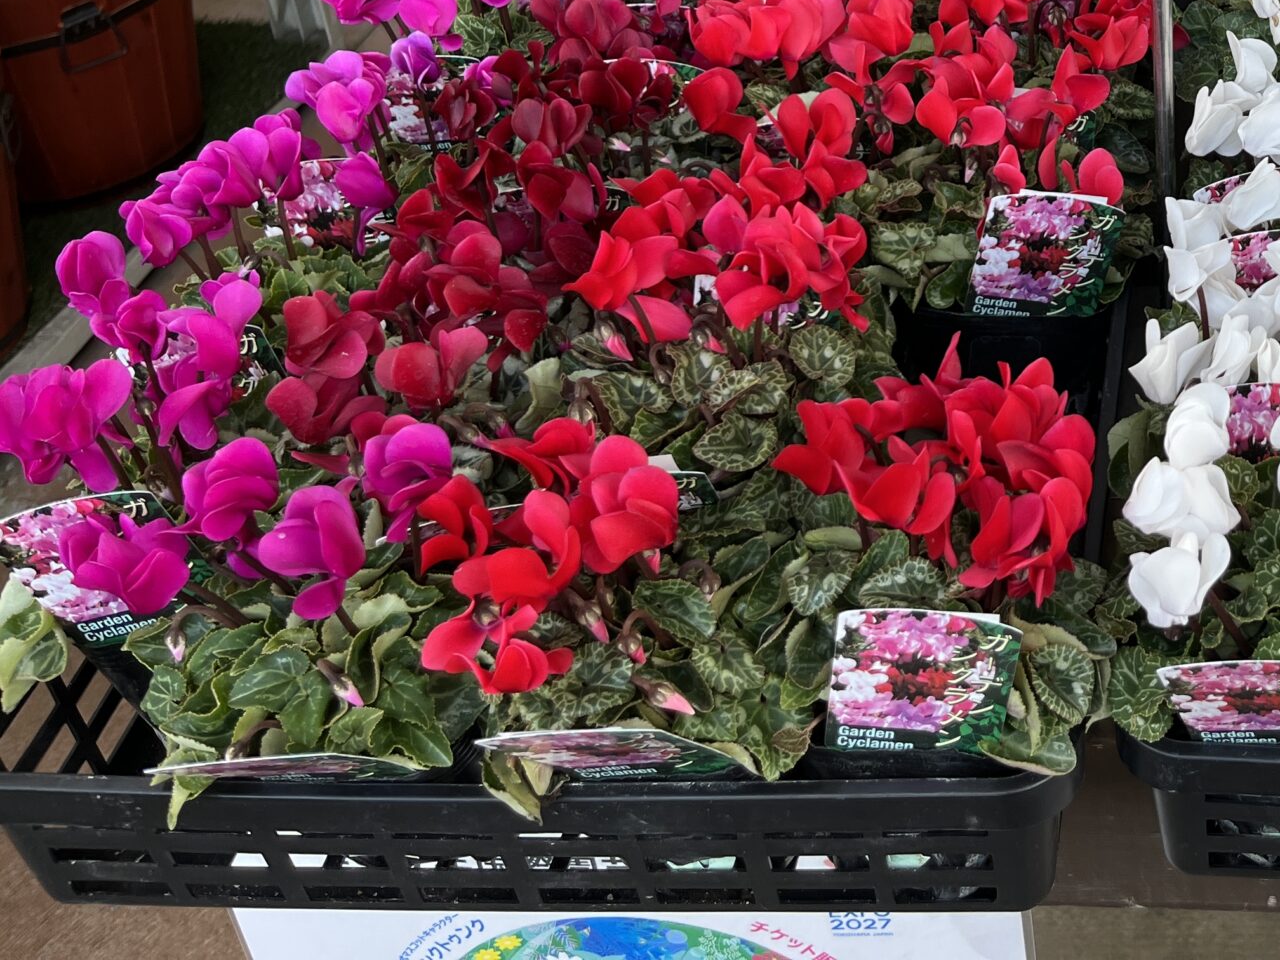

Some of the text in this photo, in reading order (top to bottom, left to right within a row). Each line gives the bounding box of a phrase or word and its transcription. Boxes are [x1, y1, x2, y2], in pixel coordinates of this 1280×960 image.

[974, 295, 1018, 310] Garden
[972, 304, 1031, 317] Cyclamen
[77, 613, 133, 633] Garden
[838, 725, 895, 739] Garden
[1200, 731, 1255, 739] Garden
[837, 736, 914, 750] Cyclamen
[830, 918, 892, 930] 2027
